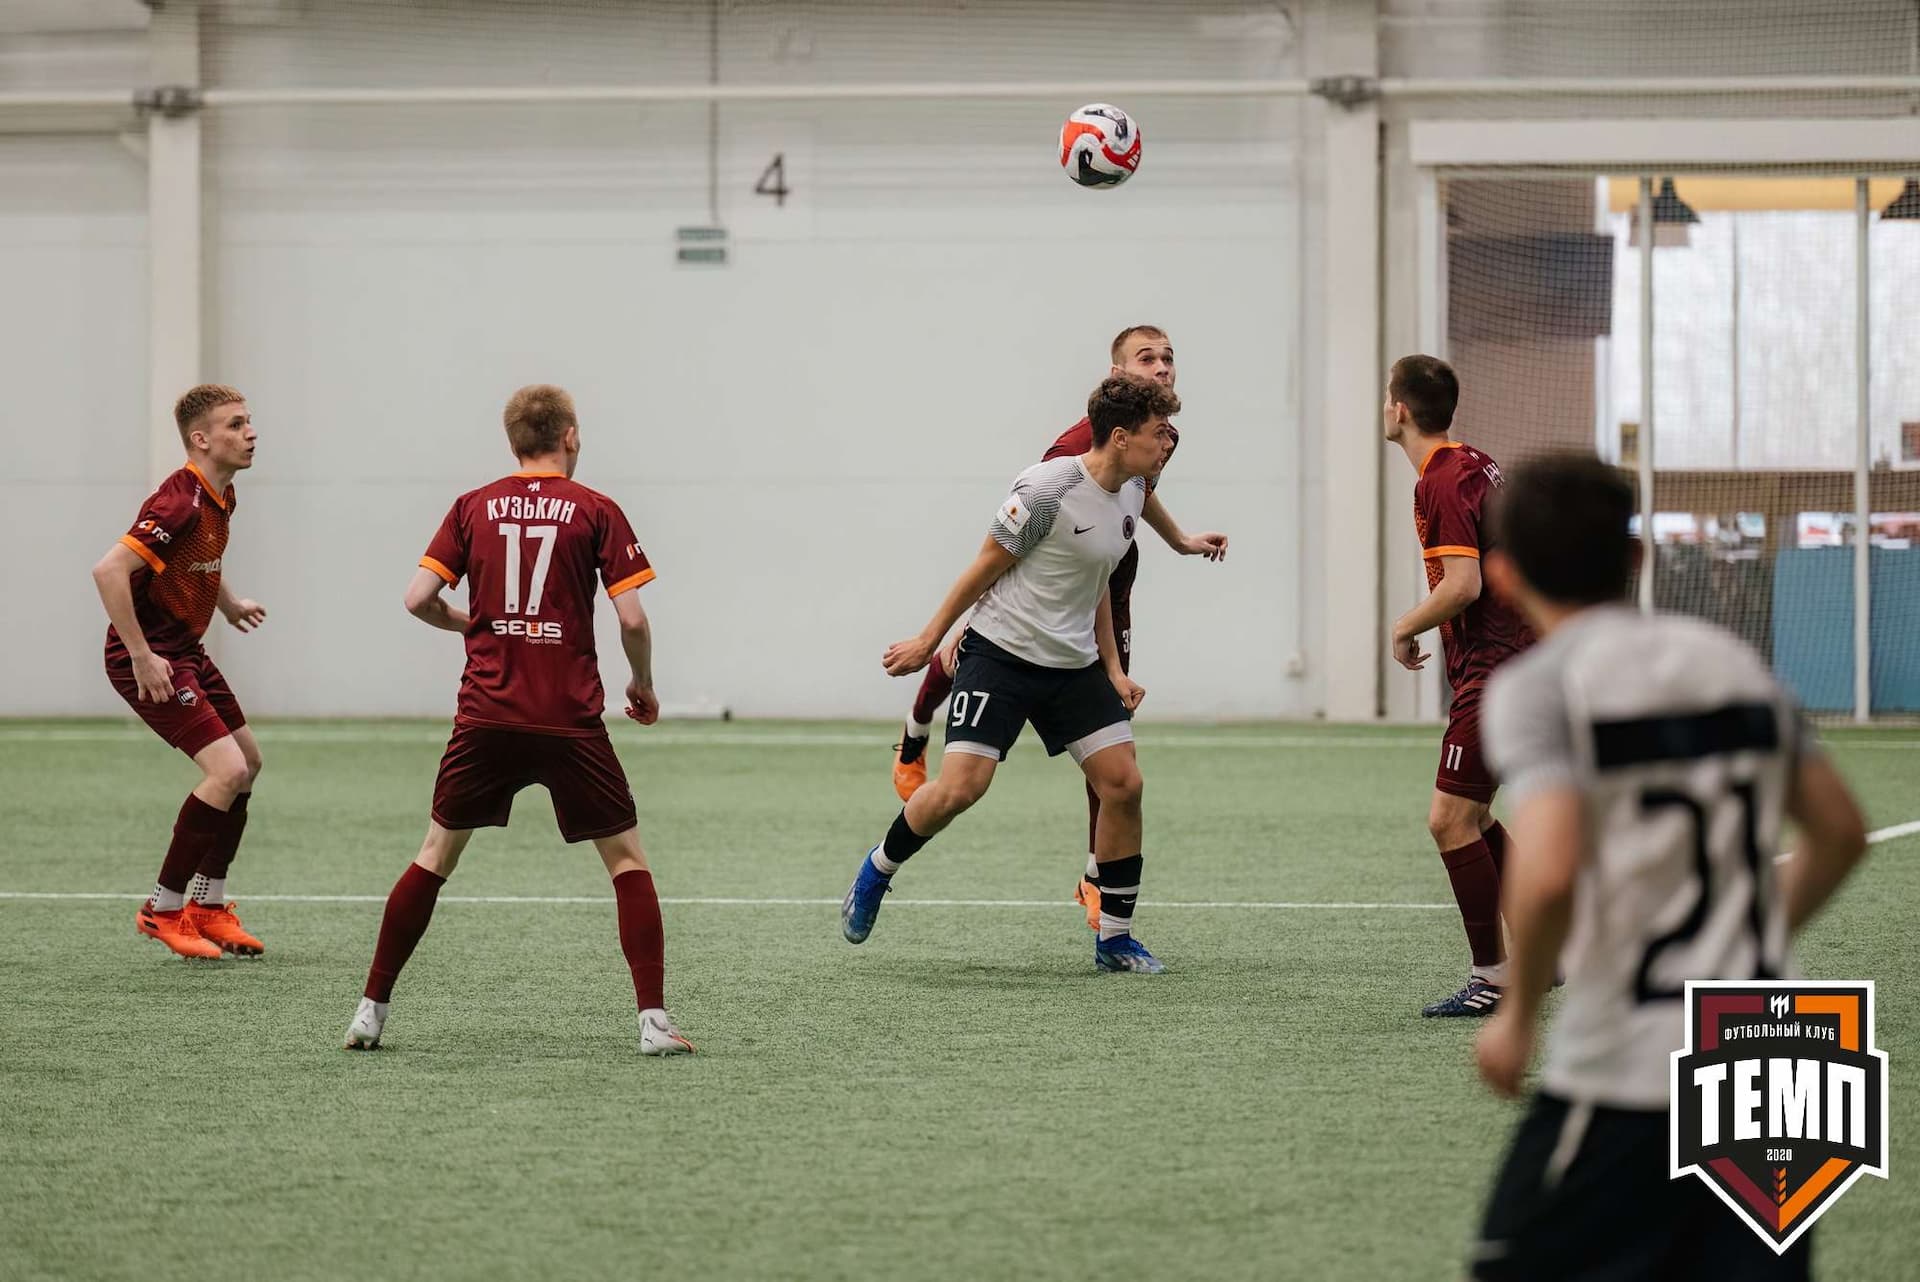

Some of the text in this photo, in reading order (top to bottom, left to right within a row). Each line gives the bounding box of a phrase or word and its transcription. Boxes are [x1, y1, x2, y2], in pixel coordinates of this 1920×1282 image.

[756, 151, 790, 207] 4
[487, 496, 577, 524] КУЗЬКИН
[499, 523, 558, 616] 17
[491, 619, 562, 638] SEUS
[952, 690, 990, 728] 97
[1446, 743, 1463, 771] 11
[1634, 780, 1778, 1008] 21
